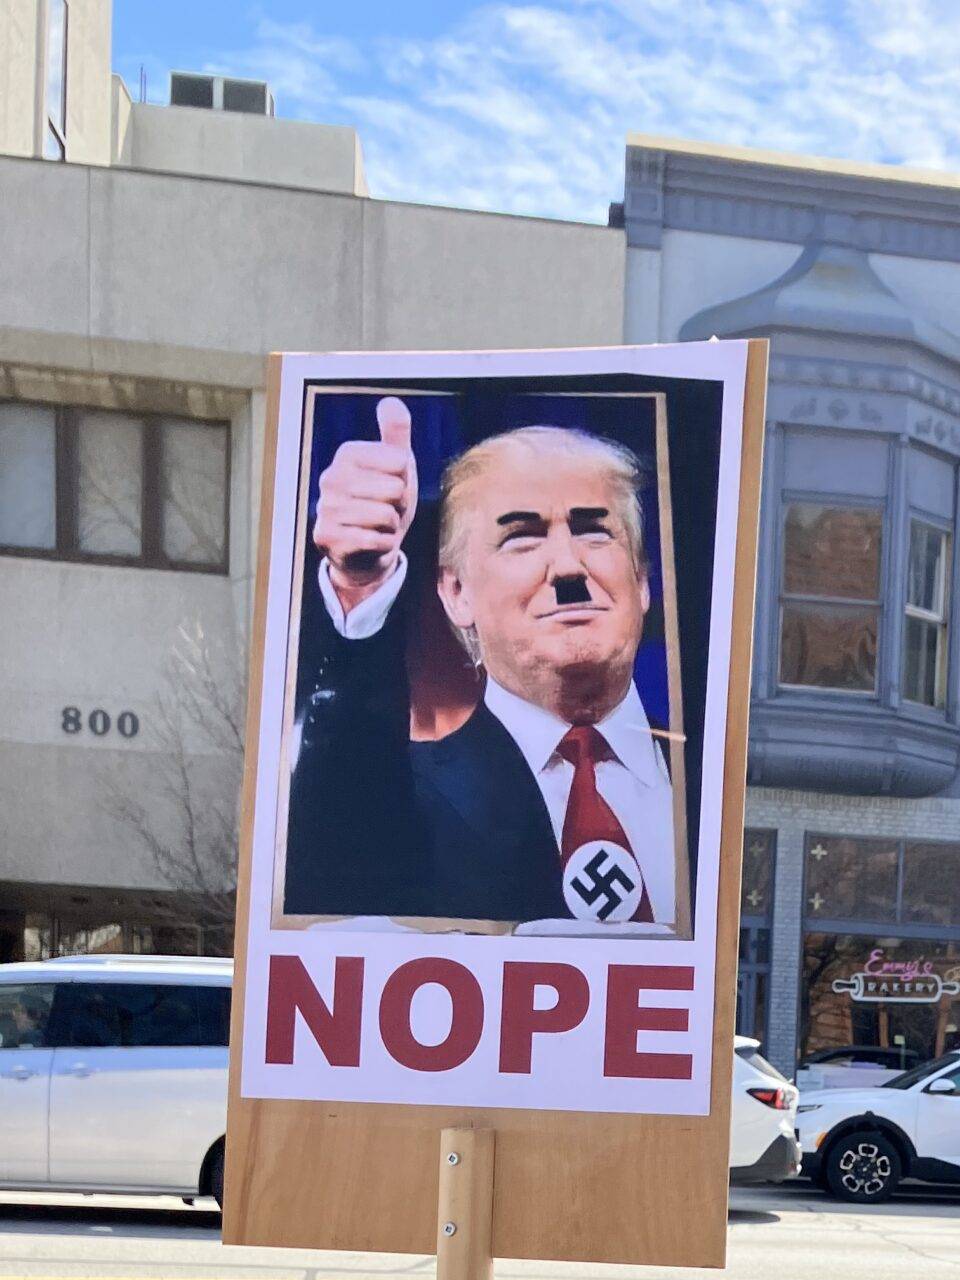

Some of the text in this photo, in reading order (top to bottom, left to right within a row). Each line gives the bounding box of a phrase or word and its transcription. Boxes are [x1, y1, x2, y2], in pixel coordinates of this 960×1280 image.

[62, 706, 140, 738] 800
[867, 981, 936, 993] BAKERY
[265, 954, 695, 1080] NOPE
